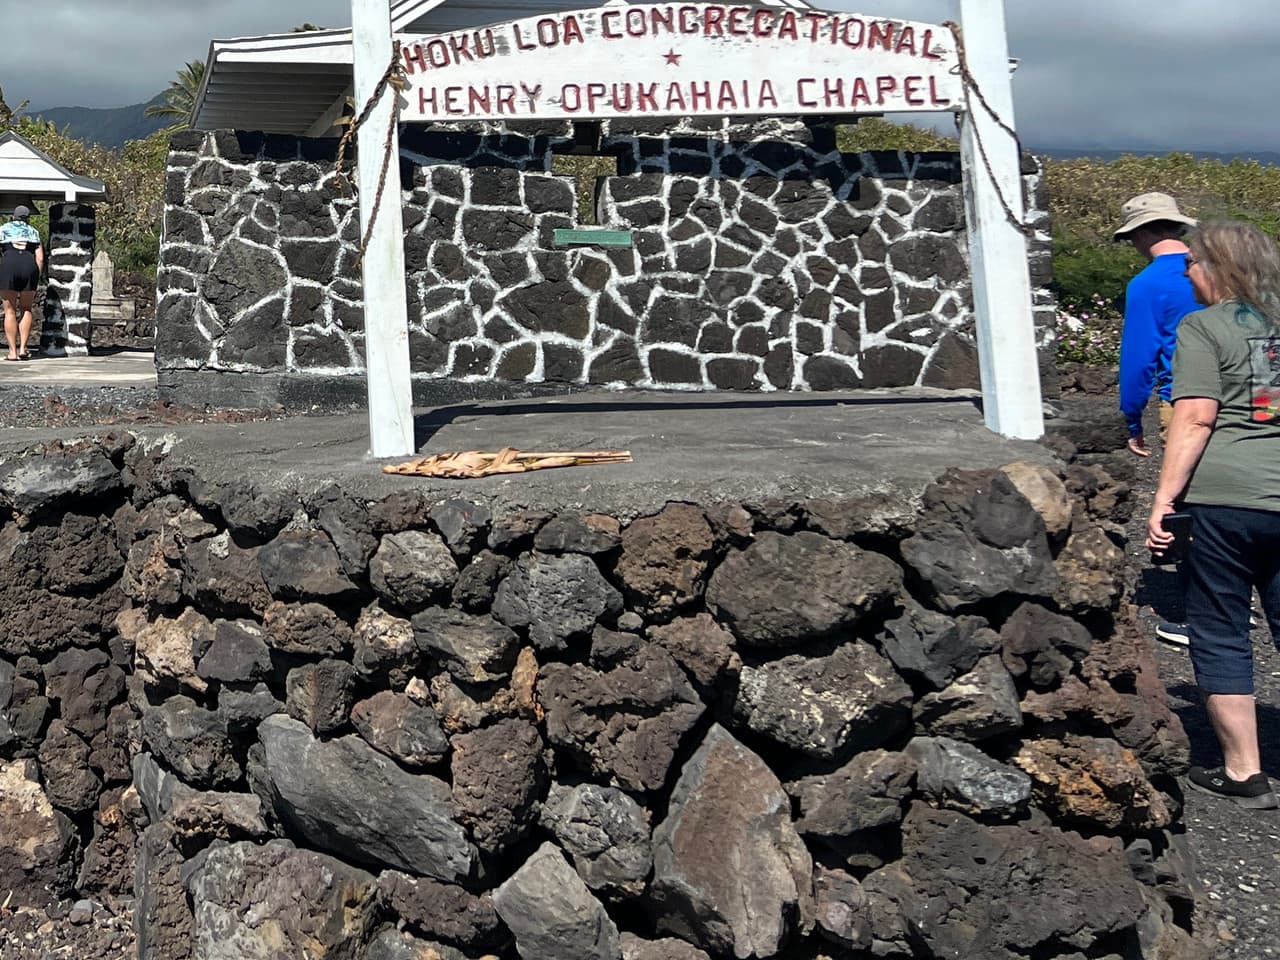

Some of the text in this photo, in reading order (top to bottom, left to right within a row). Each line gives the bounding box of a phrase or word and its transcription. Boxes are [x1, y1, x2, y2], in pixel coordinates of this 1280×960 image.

[402, 5, 942, 75] HOKU LOA CONGREGATIONAL
[418, 74, 951, 115] HENRY OPUKAHAIA CHAPEL
